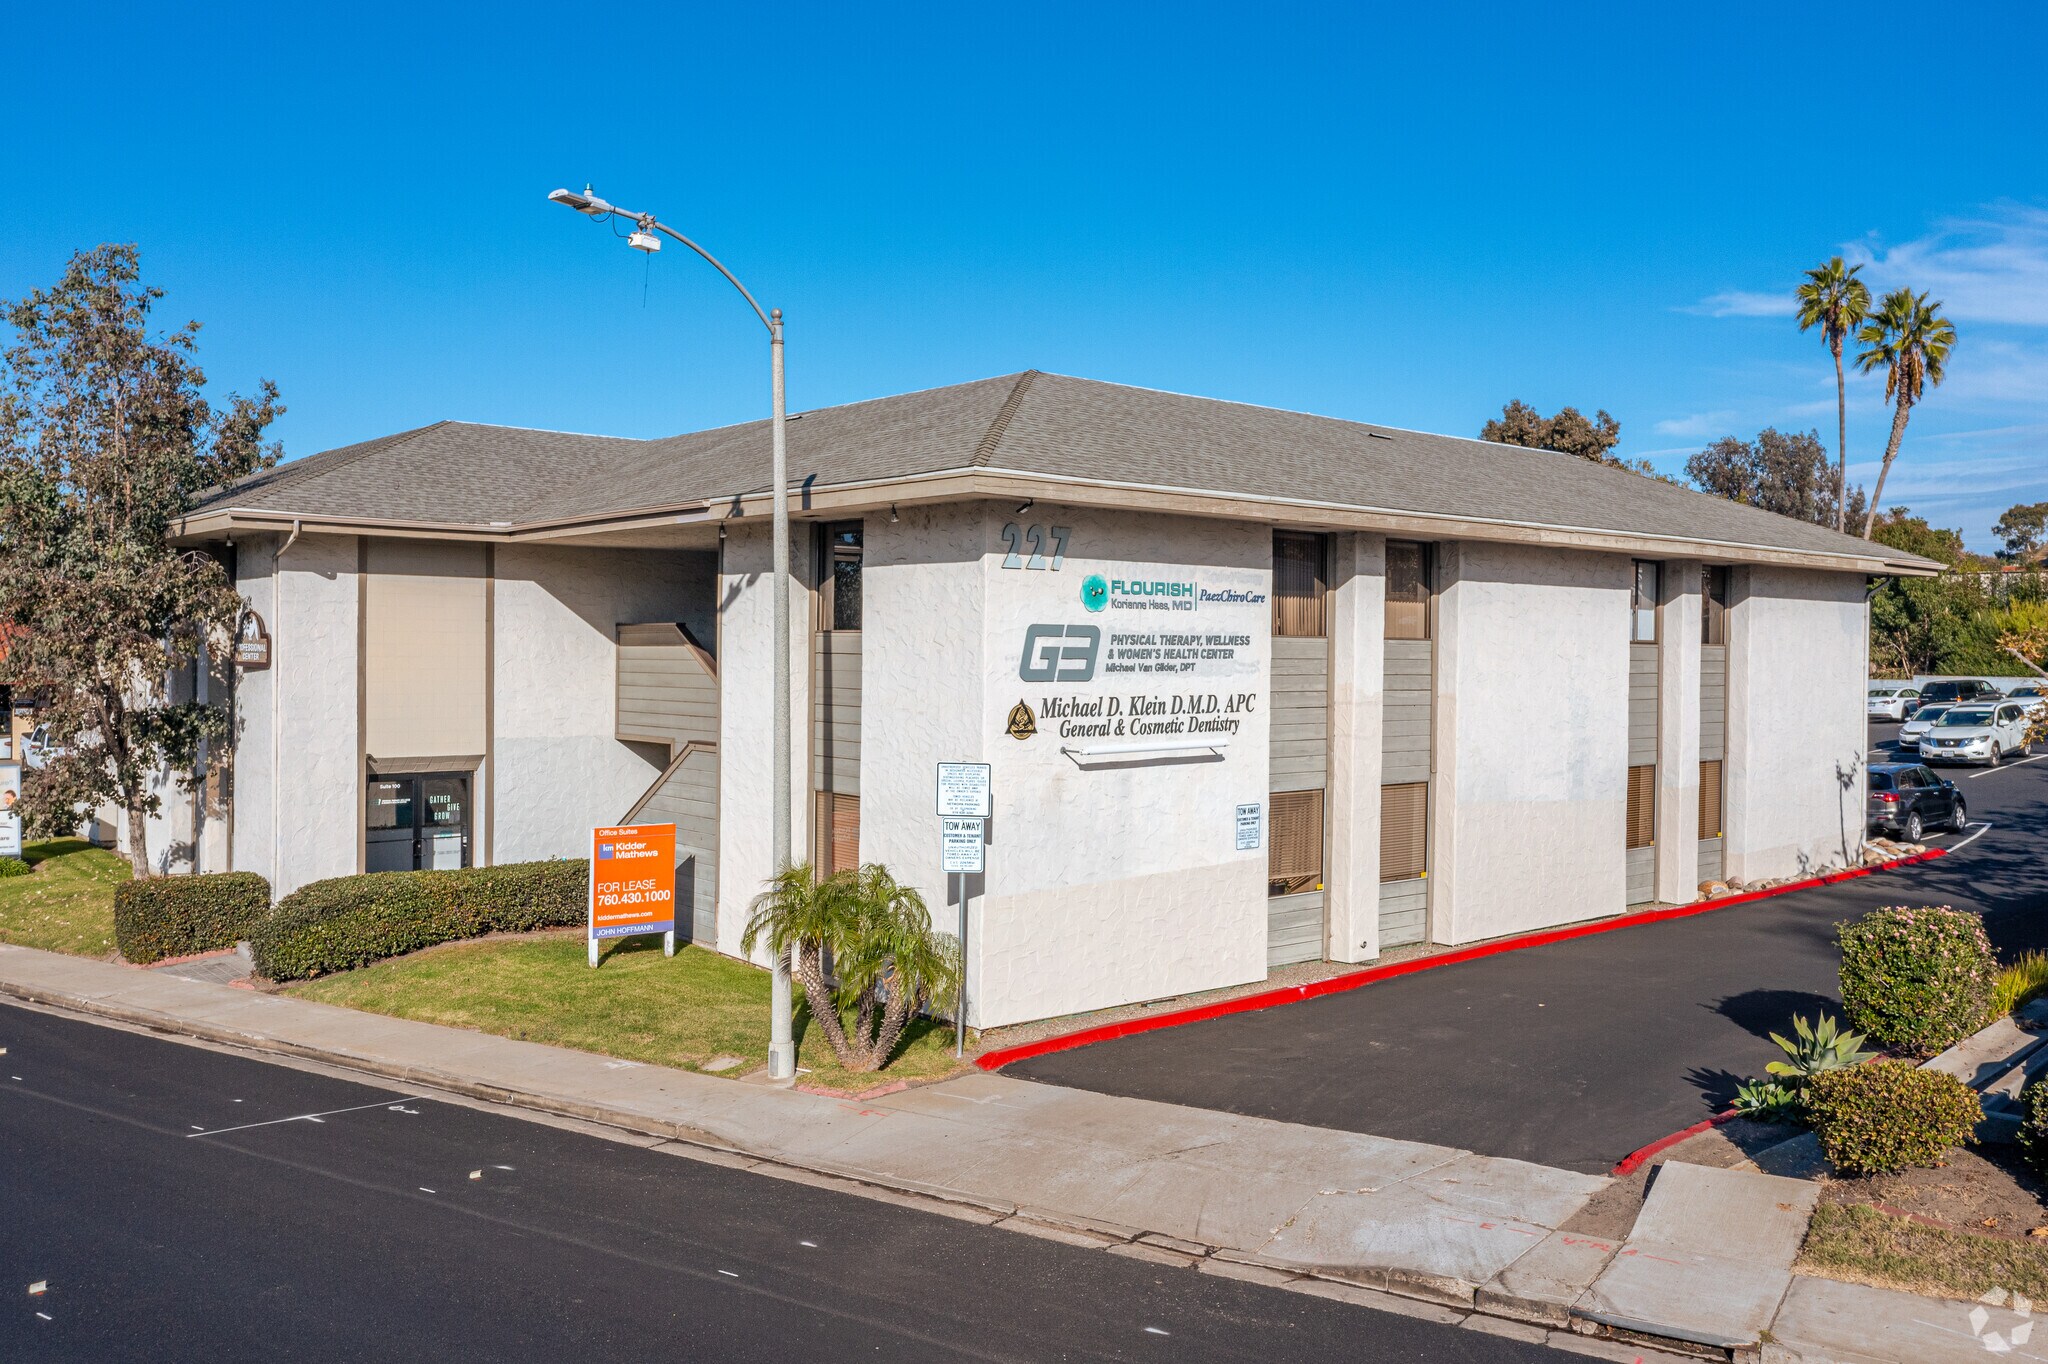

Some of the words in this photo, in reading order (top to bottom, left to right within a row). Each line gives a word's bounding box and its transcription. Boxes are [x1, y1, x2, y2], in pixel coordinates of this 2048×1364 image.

[1001, 521, 1072, 571] 227
[1111, 580, 1193, 598] FLOURISH
[1199, 588, 1266, 604] PaezChiroCare
[1111, 598, 1147, 610] Korianne
[1172, 600, 1193, 611] MD
[1110, 634, 1157, 646] PHYSICAL
[1159, 634, 1203, 647] THERAPY,
[1205, 635, 1251, 646] WELLNESS
[1107, 649, 1115, 660] &
[1117, 648, 1161, 660] WOMEN'S
[1163, 648, 1200, 660] HEALTH
[1200, 649, 1235, 660] CENTER
[1105, 663, 1136, 673] Michael
[1138, 663, 1153, 672] Van
[1180, 662, 1196, 672] DPT
[1040, 696, 1102, 718] Michael
[1106, 697, 1123, 717] D.
[1128, 695, 1166, 716] Klein
[1170, 694, 1220, 715] D.M.D.
[1224, 693, 1257, 713] APC
[1059, 718, 1111, 738] General
[1114, 719, 1126, 736] &
[1130, 716, 1185, 736] Cosmetic
[1187, 715, 1241, 735] Dentistry
[429, 795, 451, 804] GATHER
[447, 803, 460, 811] GIVE
[434, 811, 450, 820] GROW
[945, 821, 960, 831] TOW
[960, 821, 981, 831] AWAY
[599, 829, 618, 837] Office
[619, 828, 638, 836] Suites
[603, 844, 613, 852] km
[615, 842, 646, 851] Kidder
[615, 849, 658, 859] Mathews
[597, 881, 620, 893] FOR
[623, 879, 656, 891] LEASE
[597, 889, 670, 906] 760.430.1000
[597, 911, 653, 921] kiddermathews.com
[596, 927, 616, 937] JOHN
[616, 924, 654, 934] HOFFMANN
